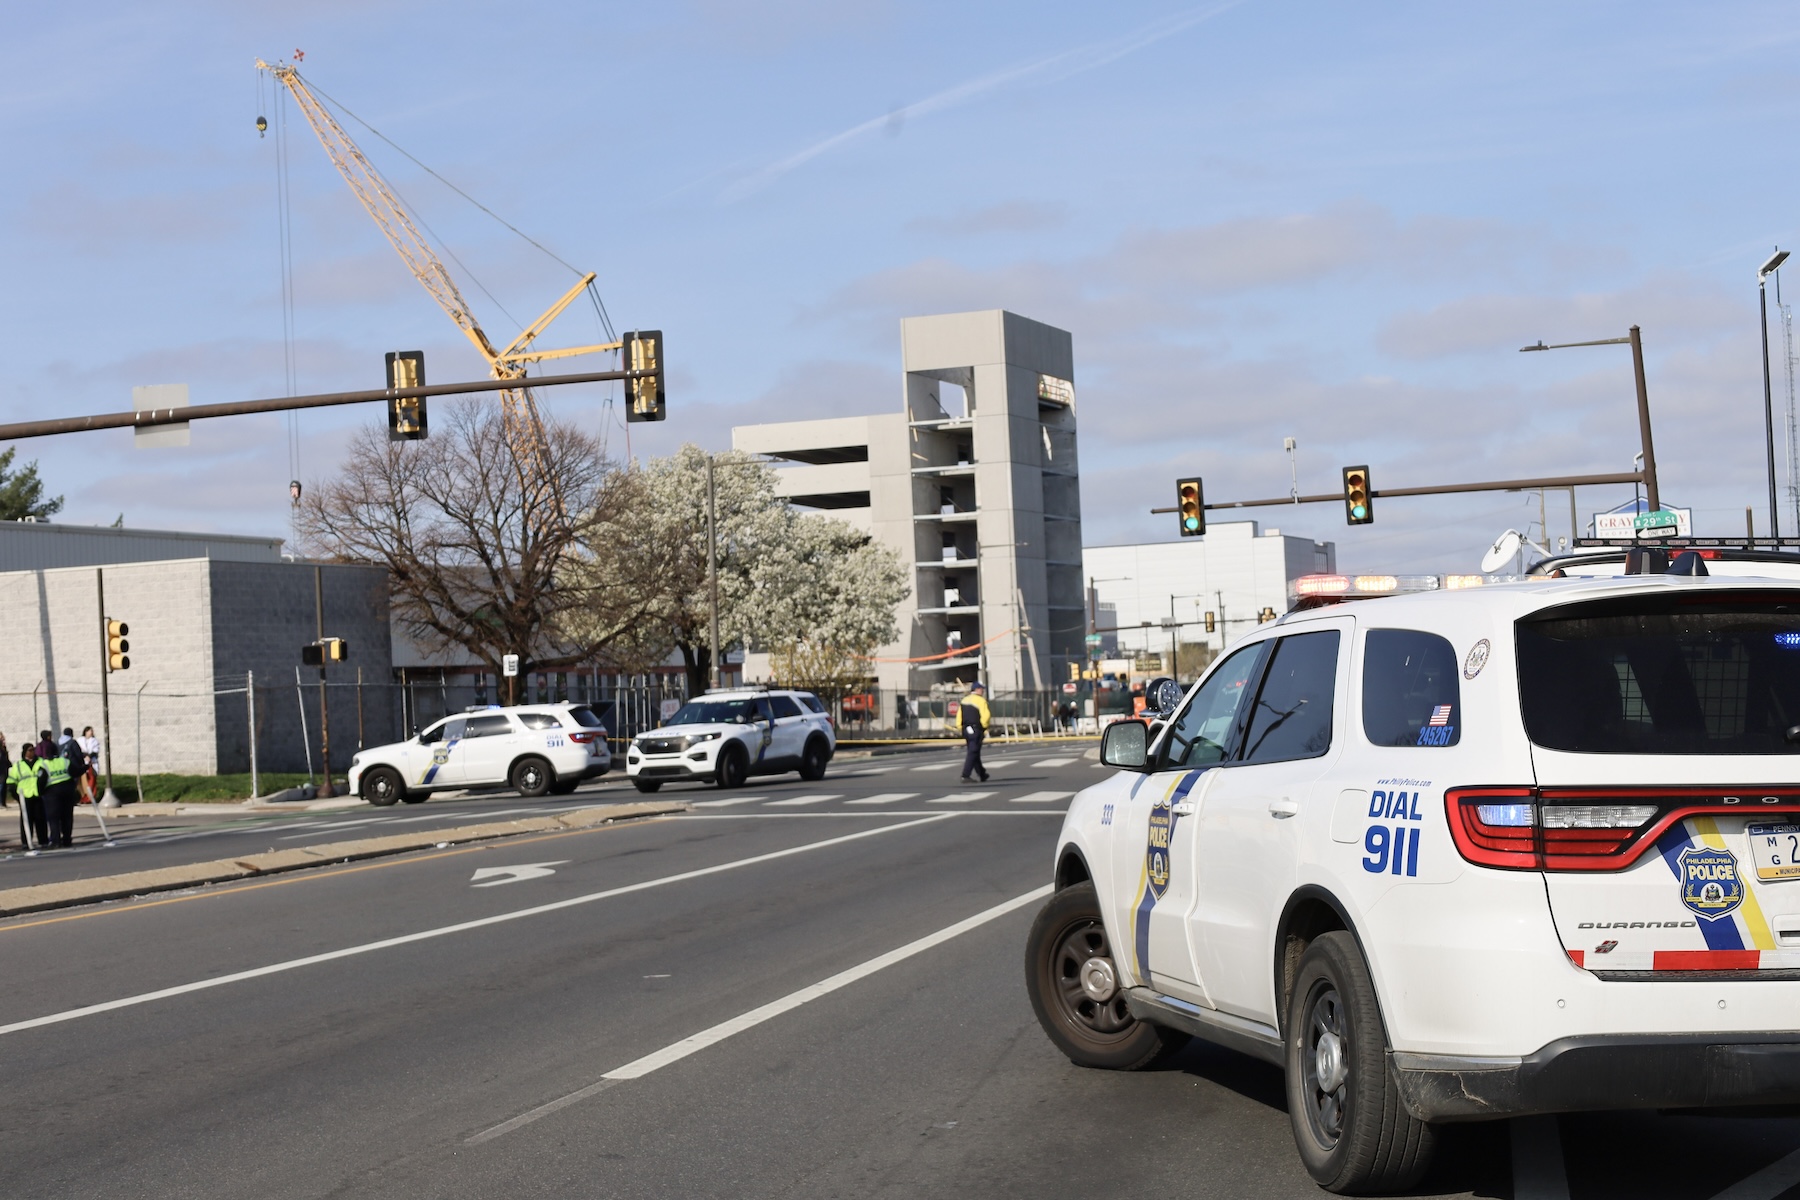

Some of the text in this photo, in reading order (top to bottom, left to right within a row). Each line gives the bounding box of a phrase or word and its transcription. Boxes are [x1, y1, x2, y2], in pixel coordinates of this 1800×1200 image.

[1600, 516, 1633, 529] GRAY
[1643, 517, 1661, 527] 29th
[1665, 515, 1676, 525] St
[1417, 726, 1454, 746] 245267
[1368, 790, 1422, 821] DIAL
[1149, 826, 1167, 848] POLICE
[1362, 825, 1420, 877] 911
[1688, 865, 1735, 881] POLICE
[1578, 921, 1696, 929] DURANGO
